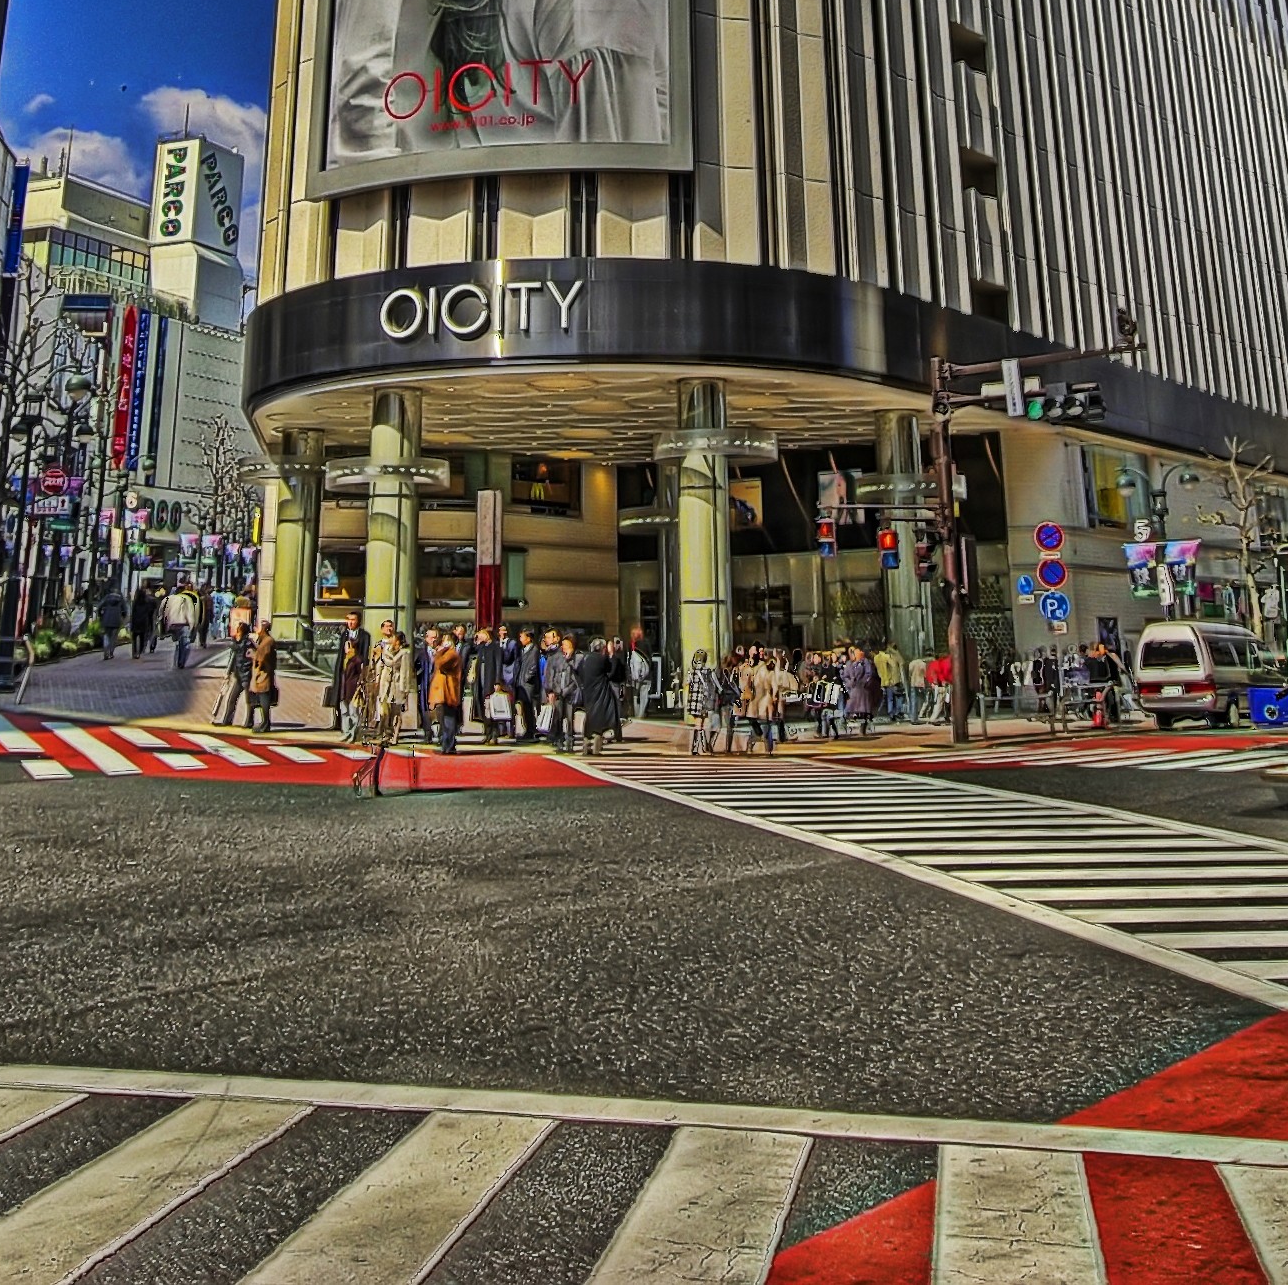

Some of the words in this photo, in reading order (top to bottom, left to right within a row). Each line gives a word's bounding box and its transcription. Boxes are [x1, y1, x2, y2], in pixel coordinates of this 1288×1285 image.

[160, 147, 188, 236] PARCO
[201, 152, 239, 247] PARCO
[379, 280, 583, 340] OICITY
